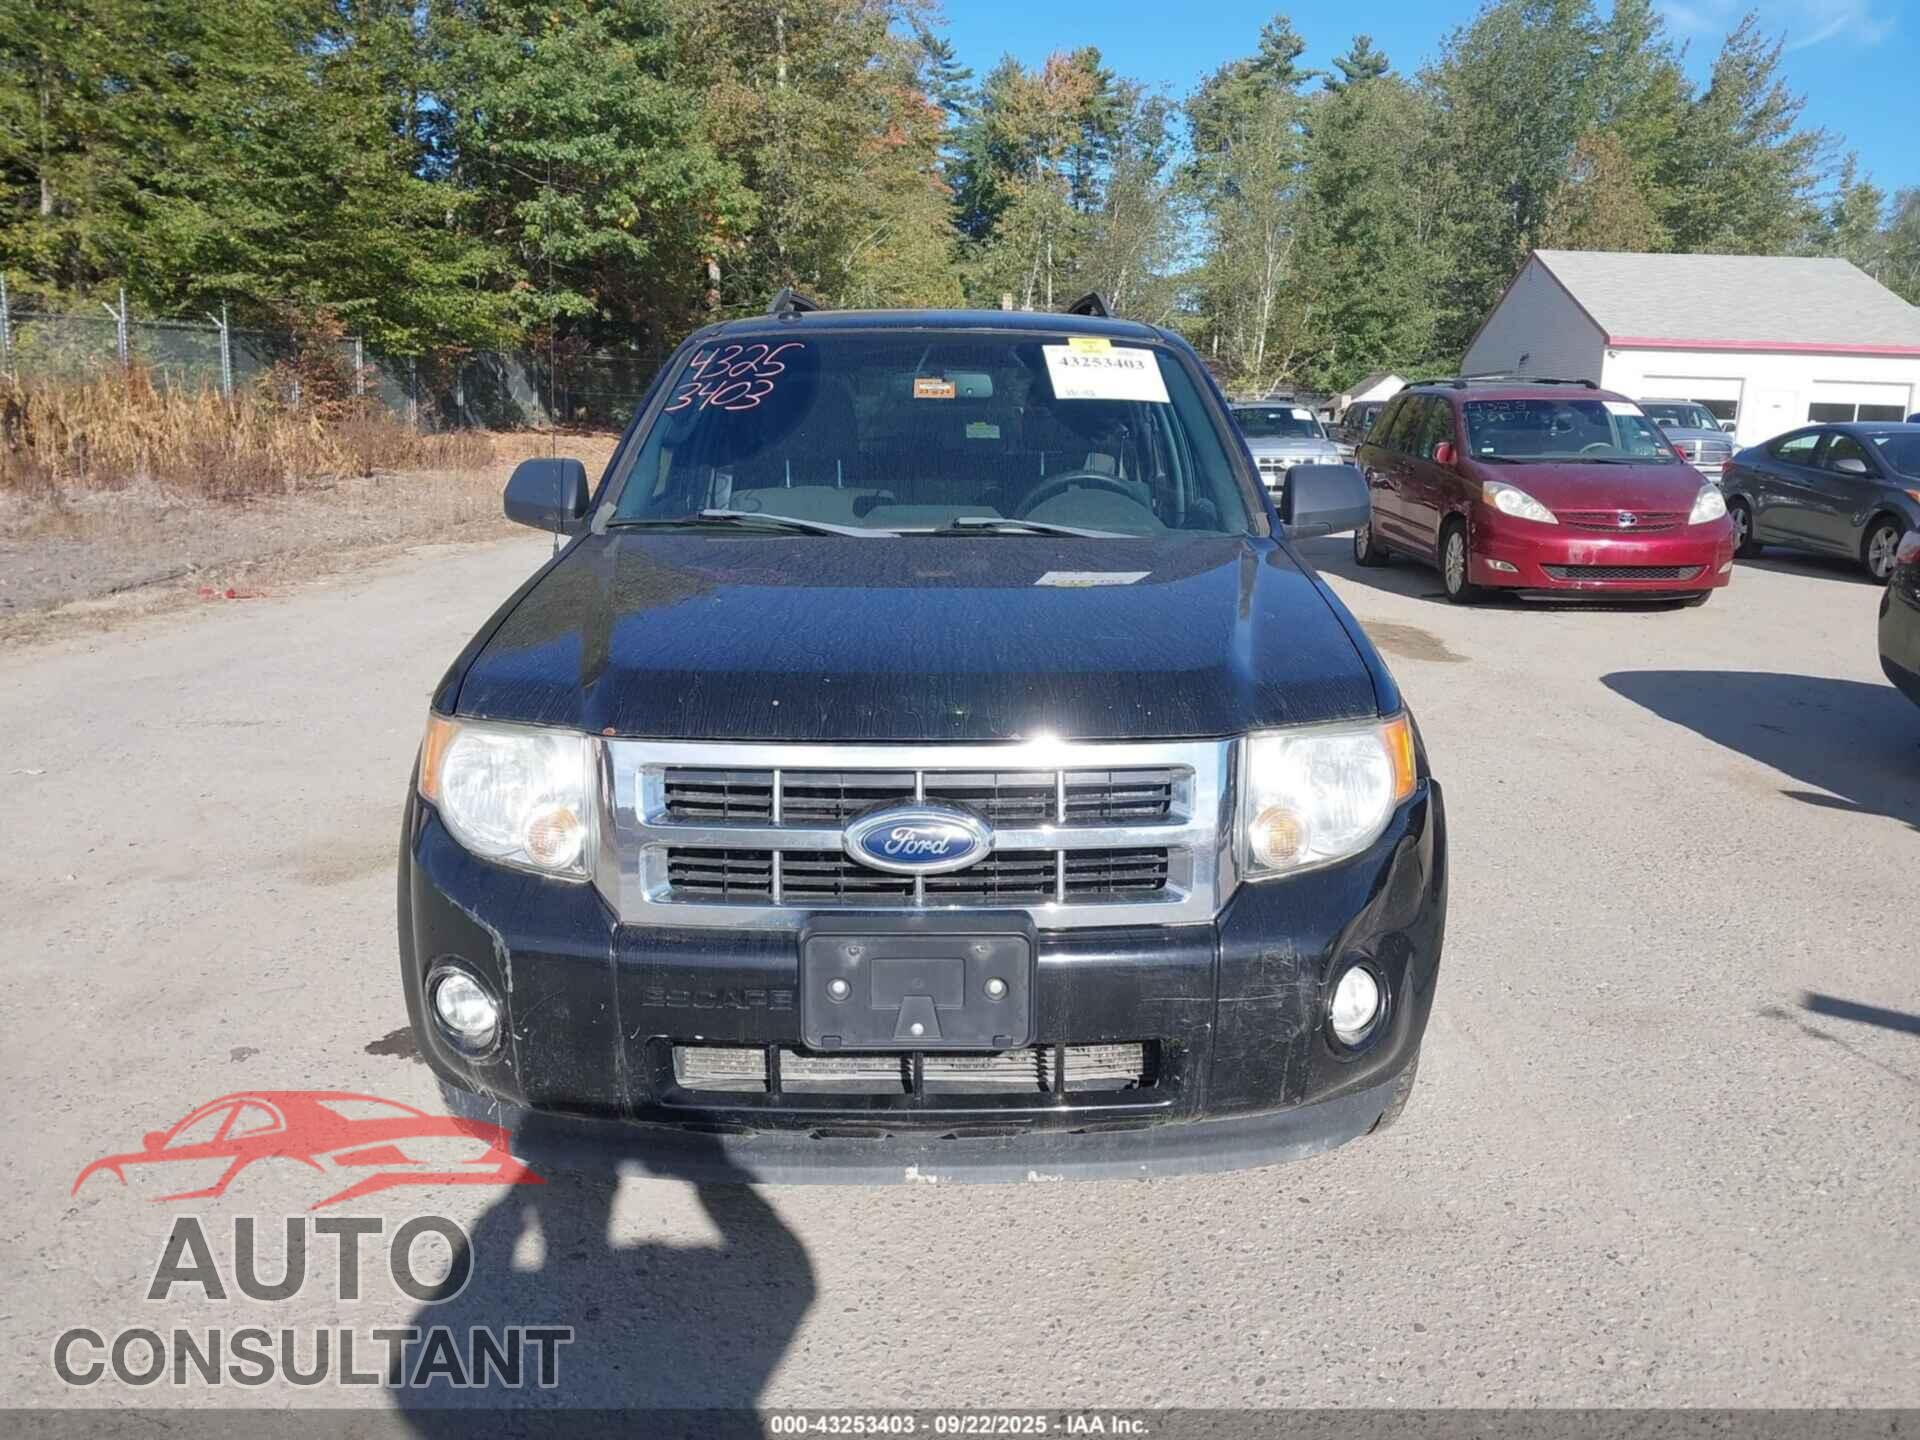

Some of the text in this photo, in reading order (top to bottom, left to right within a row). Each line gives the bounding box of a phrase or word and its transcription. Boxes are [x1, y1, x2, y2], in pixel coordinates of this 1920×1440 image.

[690, 342, 805, 381] 4325
[1059, 356, 1145, 370] 43253403
[664, 379, 774, 412] 3403
[884, 826, 951, 854] Ford
